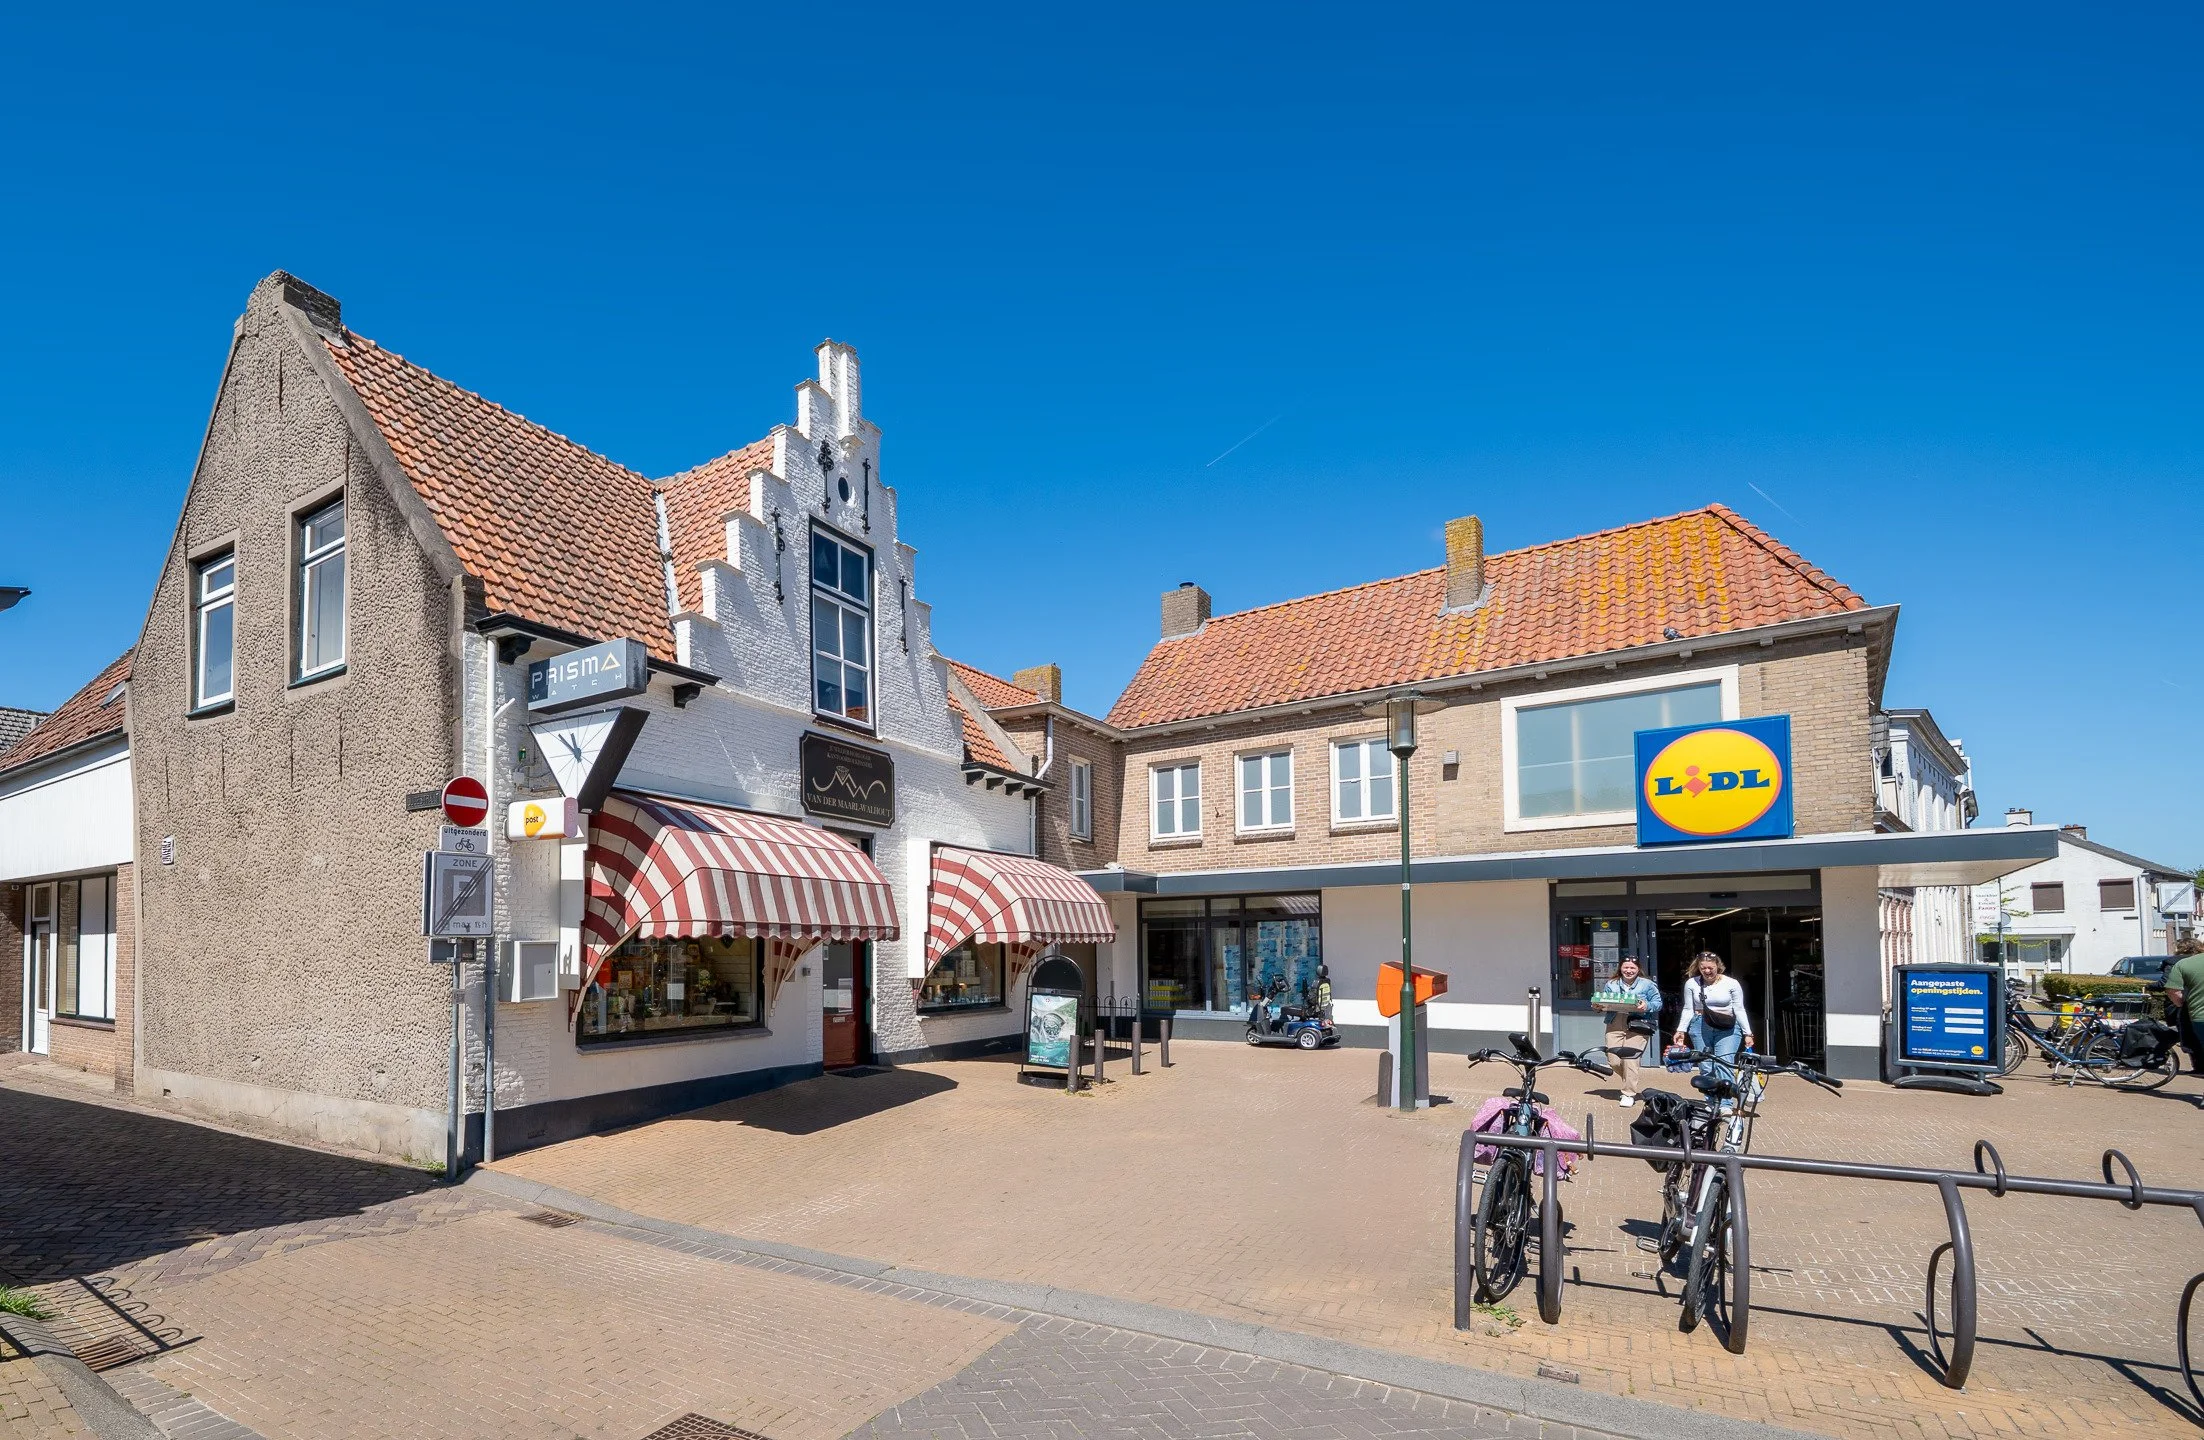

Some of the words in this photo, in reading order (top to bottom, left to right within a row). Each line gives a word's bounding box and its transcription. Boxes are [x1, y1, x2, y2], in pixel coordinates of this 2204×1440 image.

[531, 652, 621, 690] PRISMA
[806, 792, 822, 805] VAN
[823, 796, 837, 807] DER
[443, 826, 487, 837] uitgezonderd
[452, 858, 478, 868] ZONE
[1910, 979, 1966, 988] Aangepaste
[1910, 986, 1984, 996] openingstijden.
